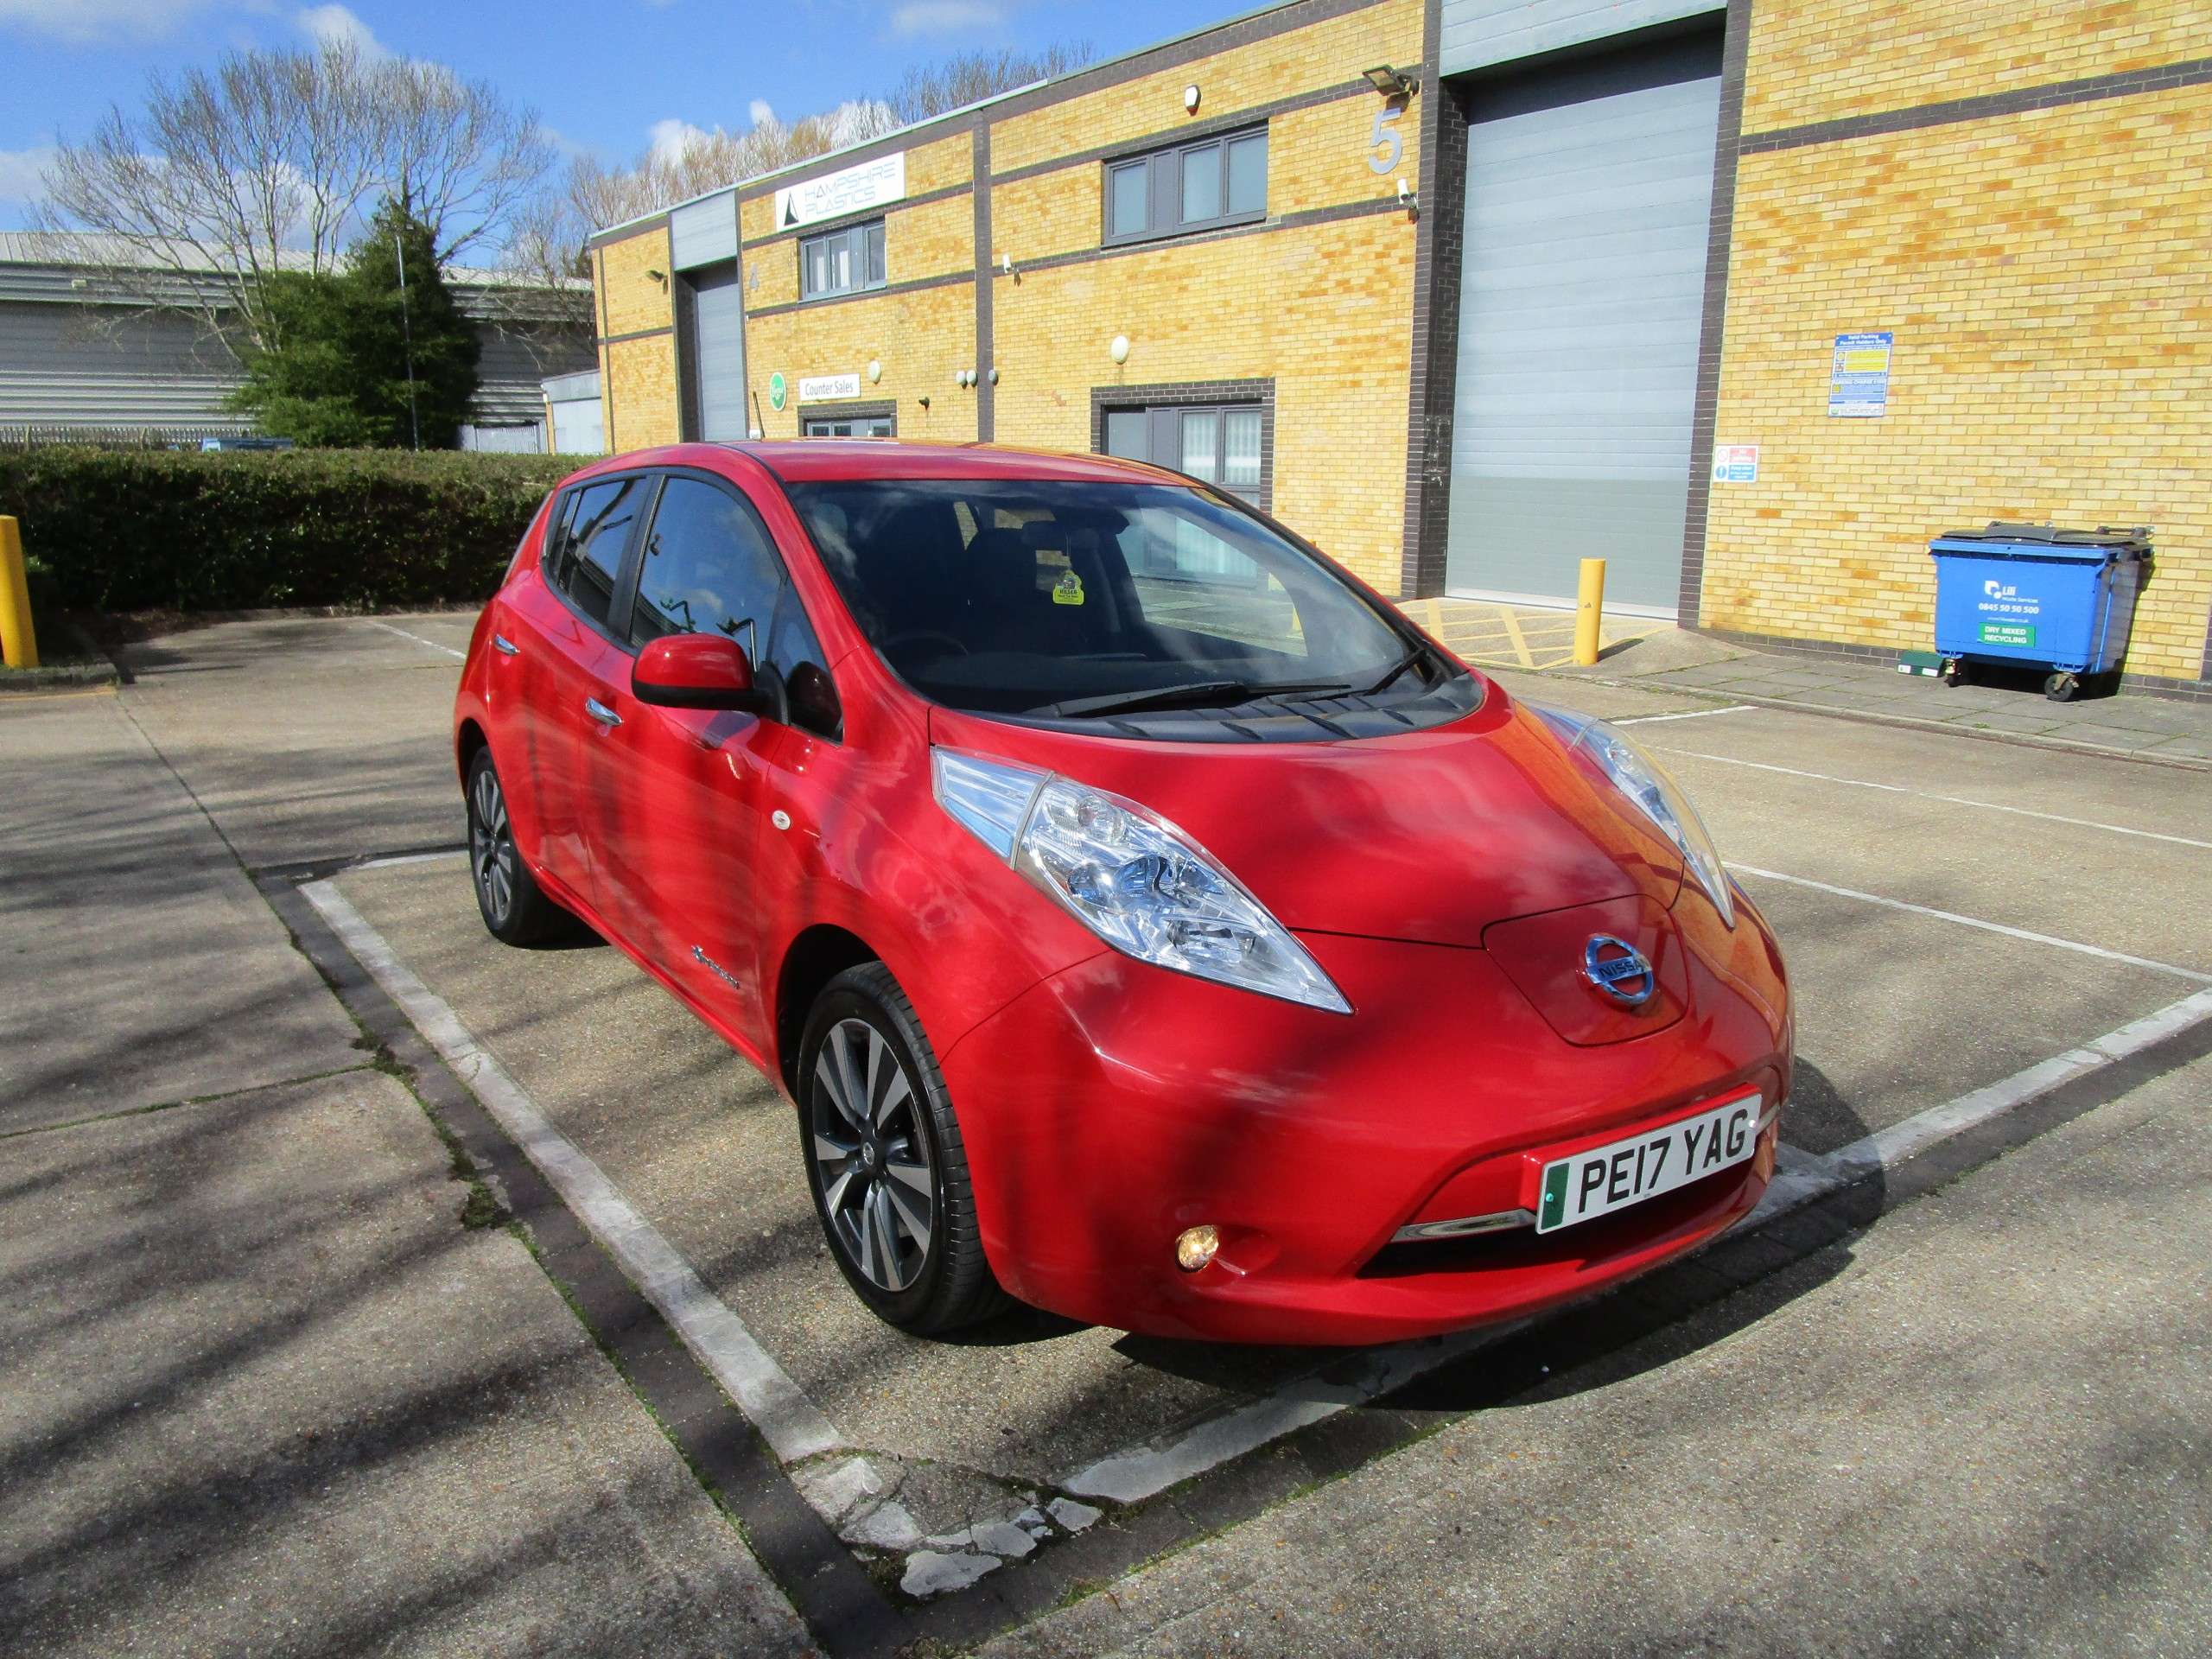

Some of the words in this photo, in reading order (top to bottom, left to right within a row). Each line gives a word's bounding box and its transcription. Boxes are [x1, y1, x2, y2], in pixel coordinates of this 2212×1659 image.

[1369, 107, 1402, 175] 5
[804, 161, 896, 203] HAMPSHIRE
[805, 185, 875, 217] PLASTICS
[805, 382, 834, 396] Counter
[835, 379, 854, 394] Sales
[1978, 602, 1999, 612] 0845
[1999, 604, 2011, 613] 50
[2023, 606, 2039, 614] 500
[1984, 626, 2000, 634] DRY
[1984, 634, 2027, 644] RECYCLING
[1578, 1135, 1671, 1214] PE17
[1684, 1109, 1748, 1175] YAG
